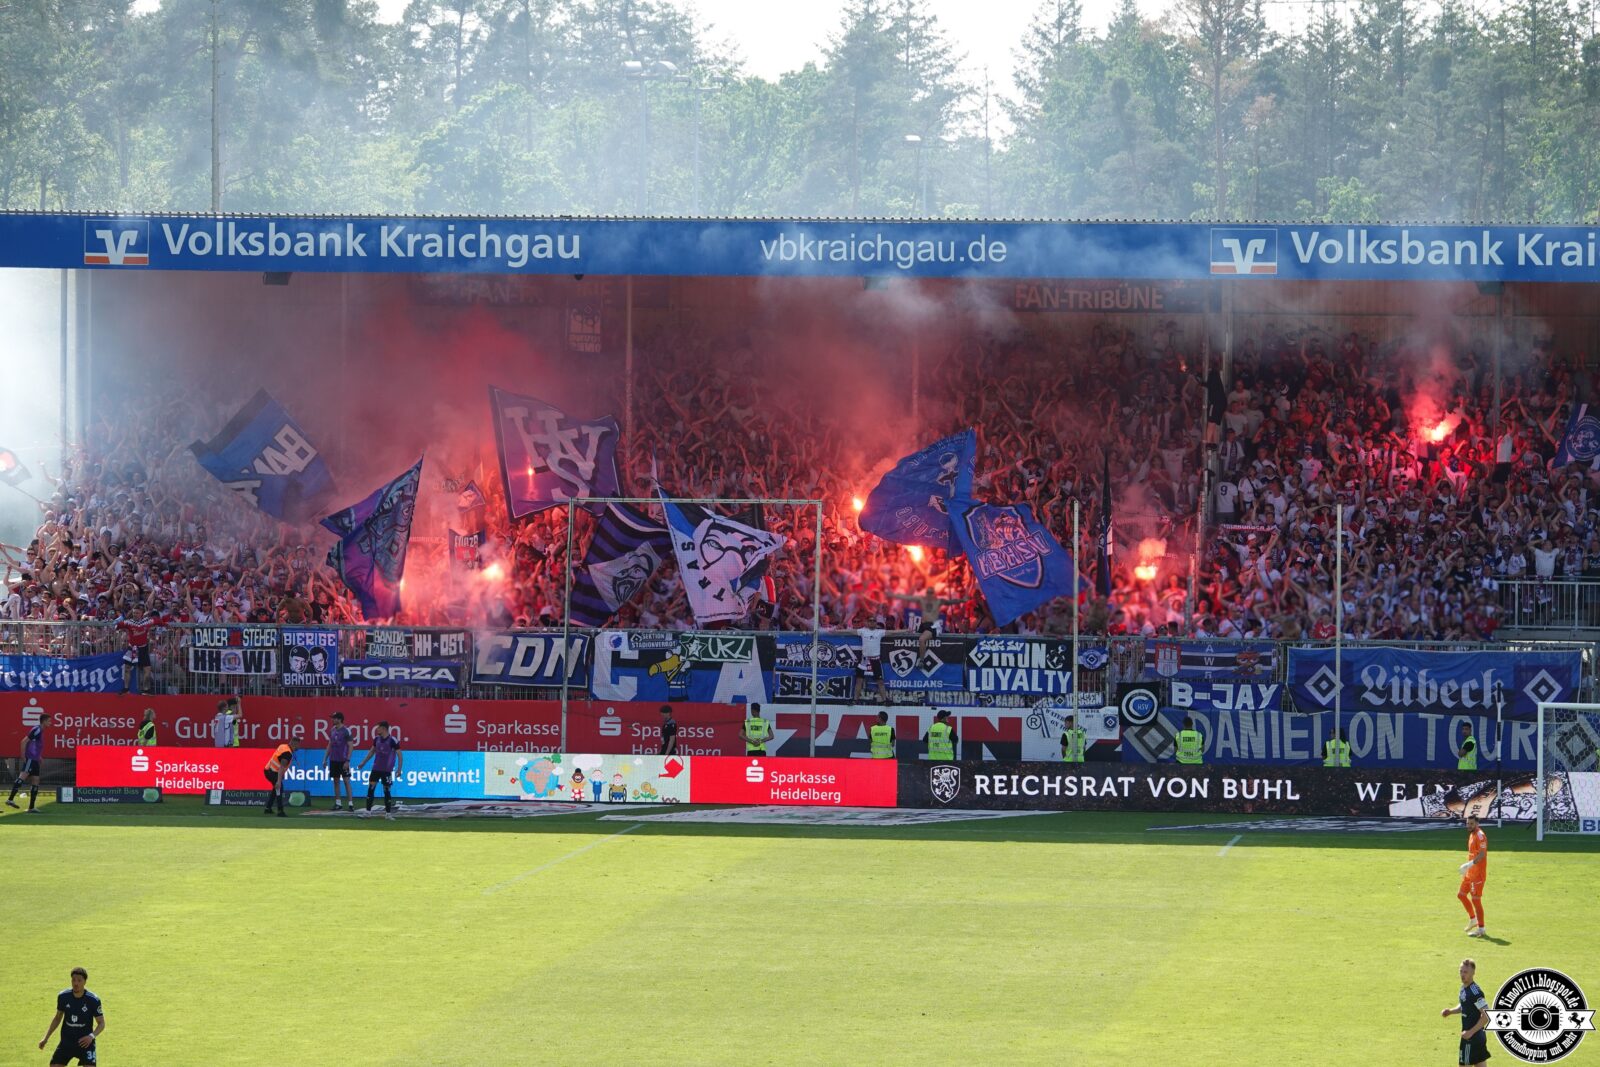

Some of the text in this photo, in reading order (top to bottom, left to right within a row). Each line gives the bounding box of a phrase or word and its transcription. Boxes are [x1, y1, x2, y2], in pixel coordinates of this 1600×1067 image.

[162, 223, 581, 268] Volksbank Kraichgau
[760, 232, 1007, 269] vbkraichgau.de
[1290, 229, 1504, 266] Volksbank
[1015, 283, 1163, 309] FAN-TRIBÜNE
[195, 628, 277, 646] DAUER STEHER
[283, 632, 336, 646] BIERIGE
[374, 631, 405, 644] BANDA
[894, 640, 941, 648] HAMBRG
[283, 673, 336, 686] BANDITEN
[343, 666, 455, 682] FORZA
[969, 668, 1072, 694] LOYALTY
[889, 680, 943, 688] HOOLIGANS
[1360, 664, 1507, 709] Lübeck
[1066, 692, 1103, 706] HSSEN
[1171, 682, 1278, 710] B-JAY
[53, 712, 136, 736] Sparkasse
[237, 718, 260, 739] ür
[267, 717, 305, 740] die
[476, 720, 560, 737] Sparkasse
[631, 722, 715, 740] Spaasse
[1350, 711, 1404, 760] ON
[155, 761, 219, 777] Sparkasse
[406, 767, 480, 786] gewinnt!
[155, 777, 225, 790] Heidelberg
[770, 771, 836, 787] Sparkasse
[975, 775, 1300, 800] REICHSRAT VON BUHL
[77, 786, 107, 795] Küchen
[109, 787, 122, 795] mit
[770, 787, 841, 803] Heidelberg
